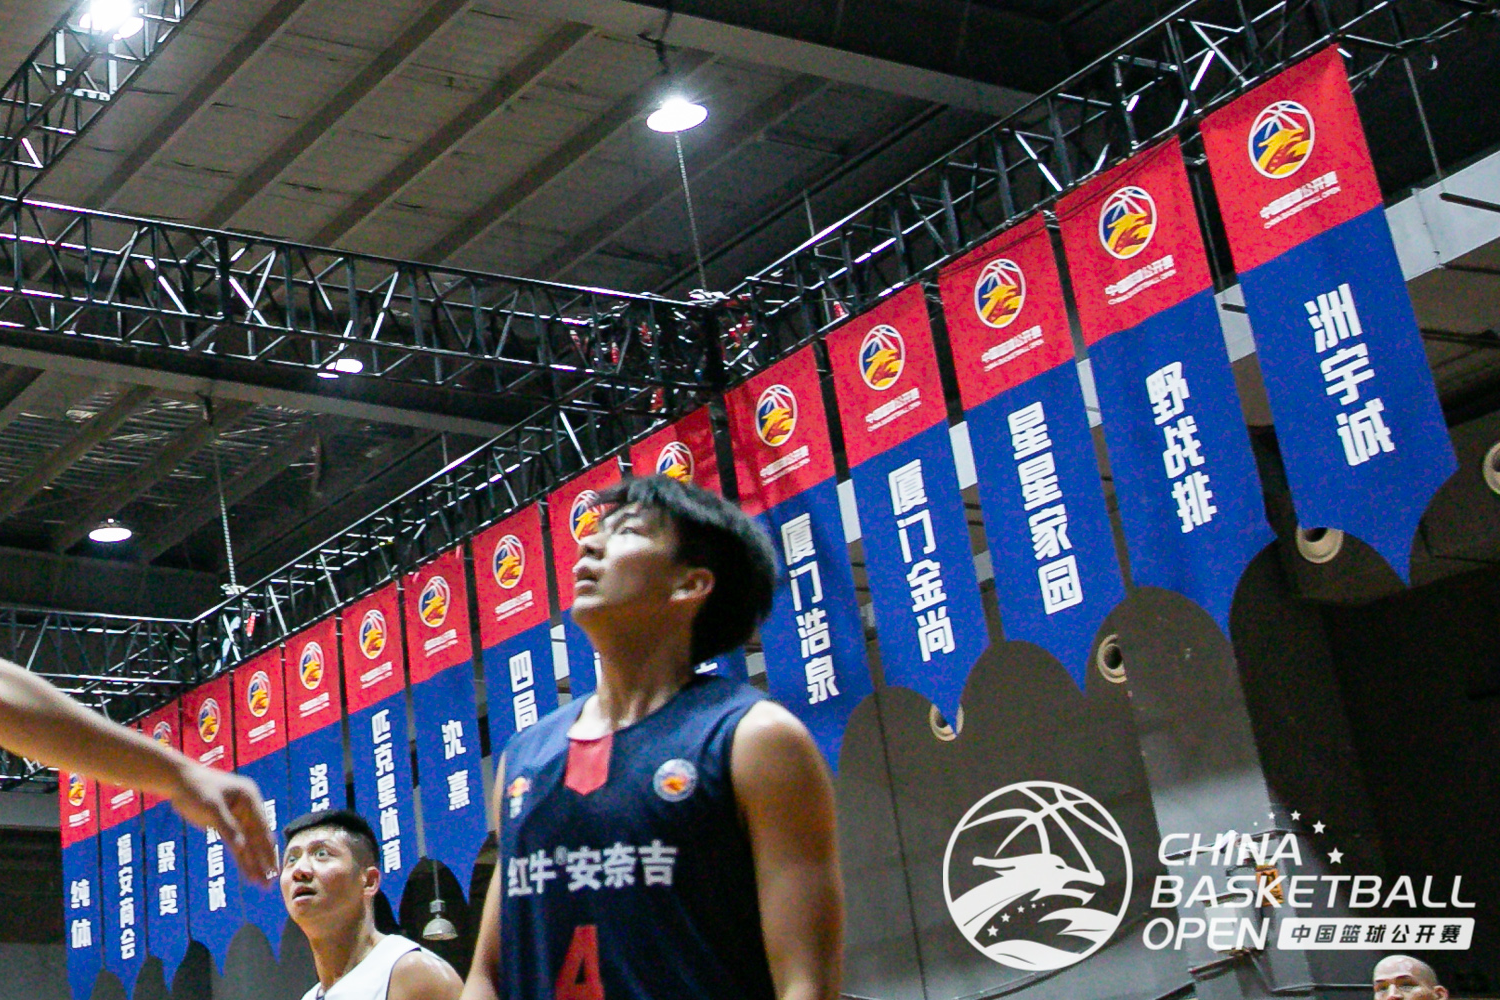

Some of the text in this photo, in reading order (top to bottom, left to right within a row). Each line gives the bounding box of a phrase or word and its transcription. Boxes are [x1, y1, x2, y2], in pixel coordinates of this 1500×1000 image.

[1145, 360, 1218, 534] 野战排
[1303, 283, 1395, 467] 洲宇诚
[888, 458, 956, 663] 厦门金尚
[1006, 401, 1084, 615] 星星家园
[780, 512, 840, 705] 厦门浩泉
[371, 709, 402, 874] 匹克星体育
